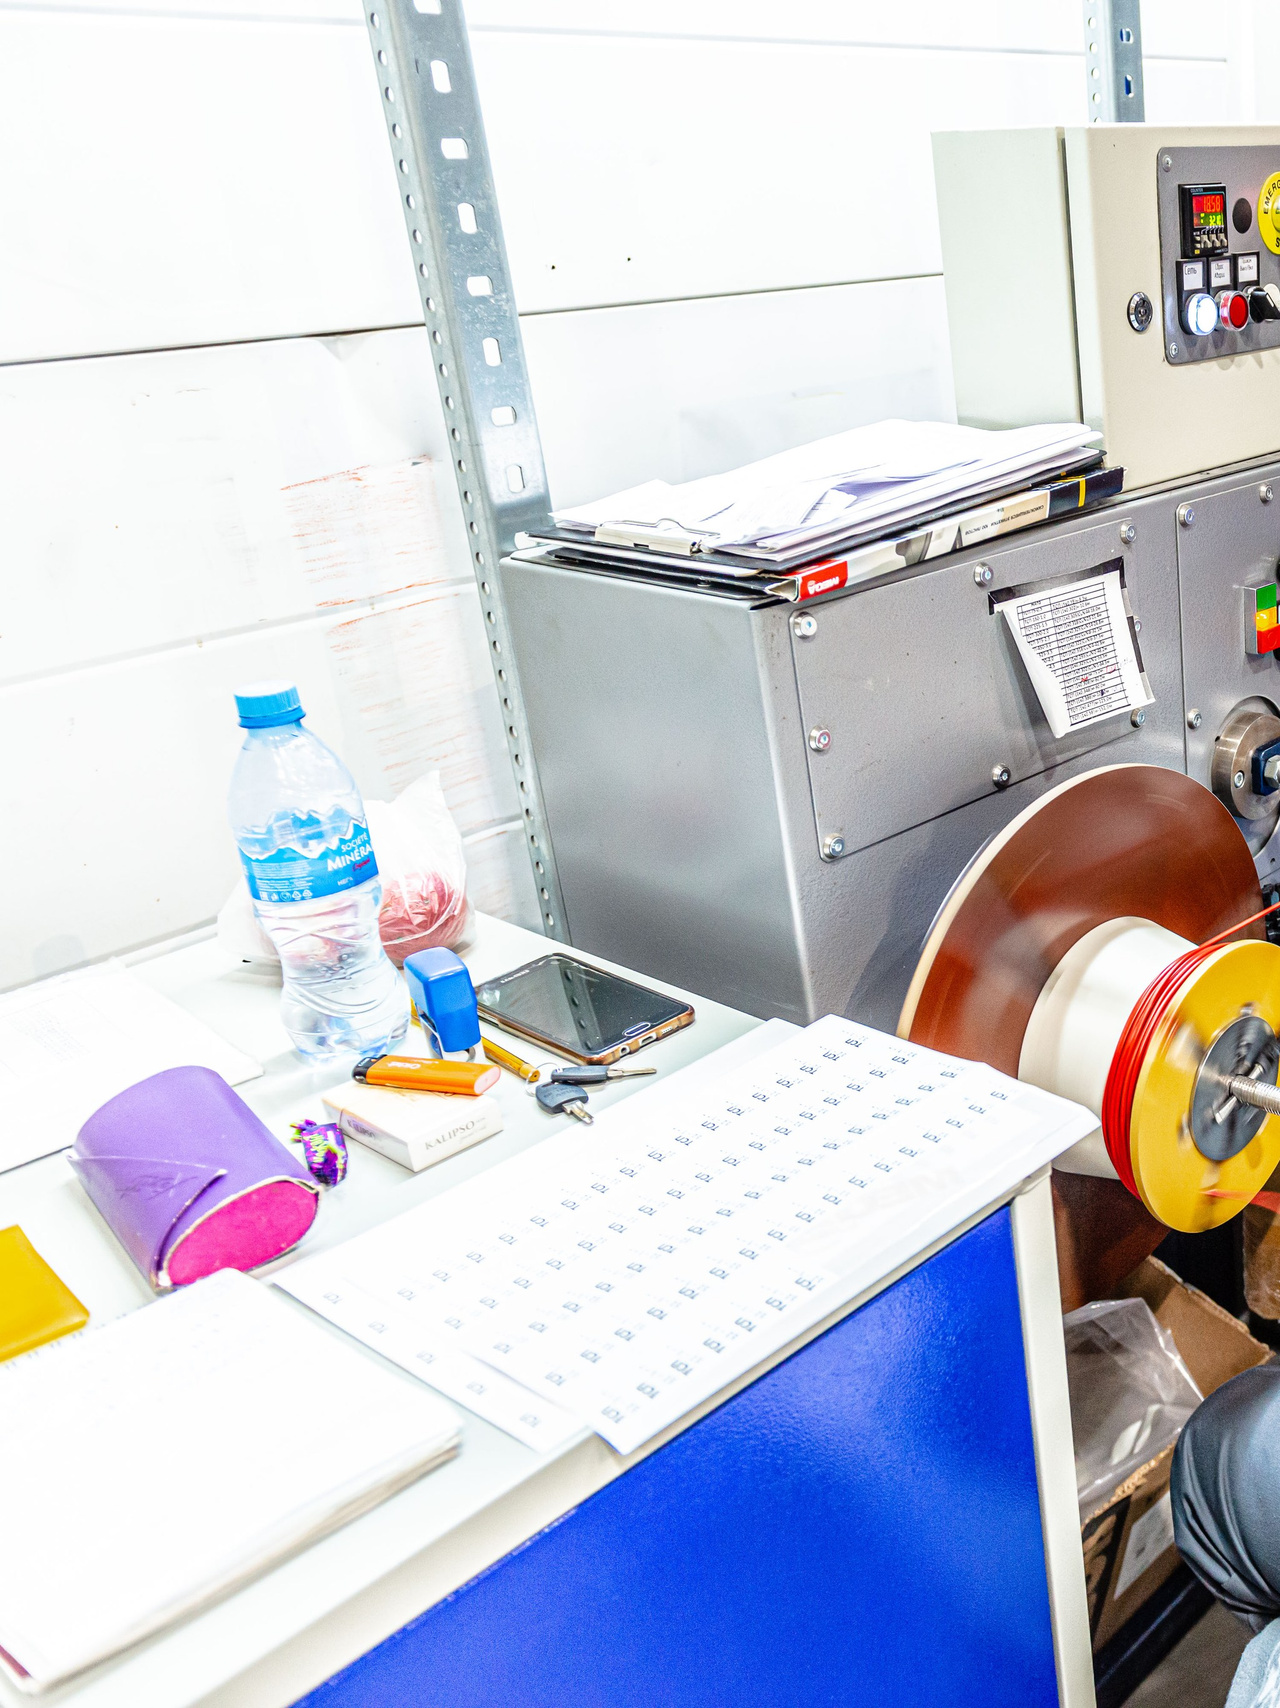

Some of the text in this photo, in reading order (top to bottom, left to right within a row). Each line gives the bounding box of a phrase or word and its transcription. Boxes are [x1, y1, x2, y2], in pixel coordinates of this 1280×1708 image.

[990, 516, 1010, 527] ЭТИКЕТКИ
[1010, 504, 1044, 520] САМОКЛЕЯЩИЕСЯ
[807, 576, 840, 595] MEGA
[341, 831, 368, 853] SOCIÉTÉ
[424, 1119, 475, 1150] KALIPSO
